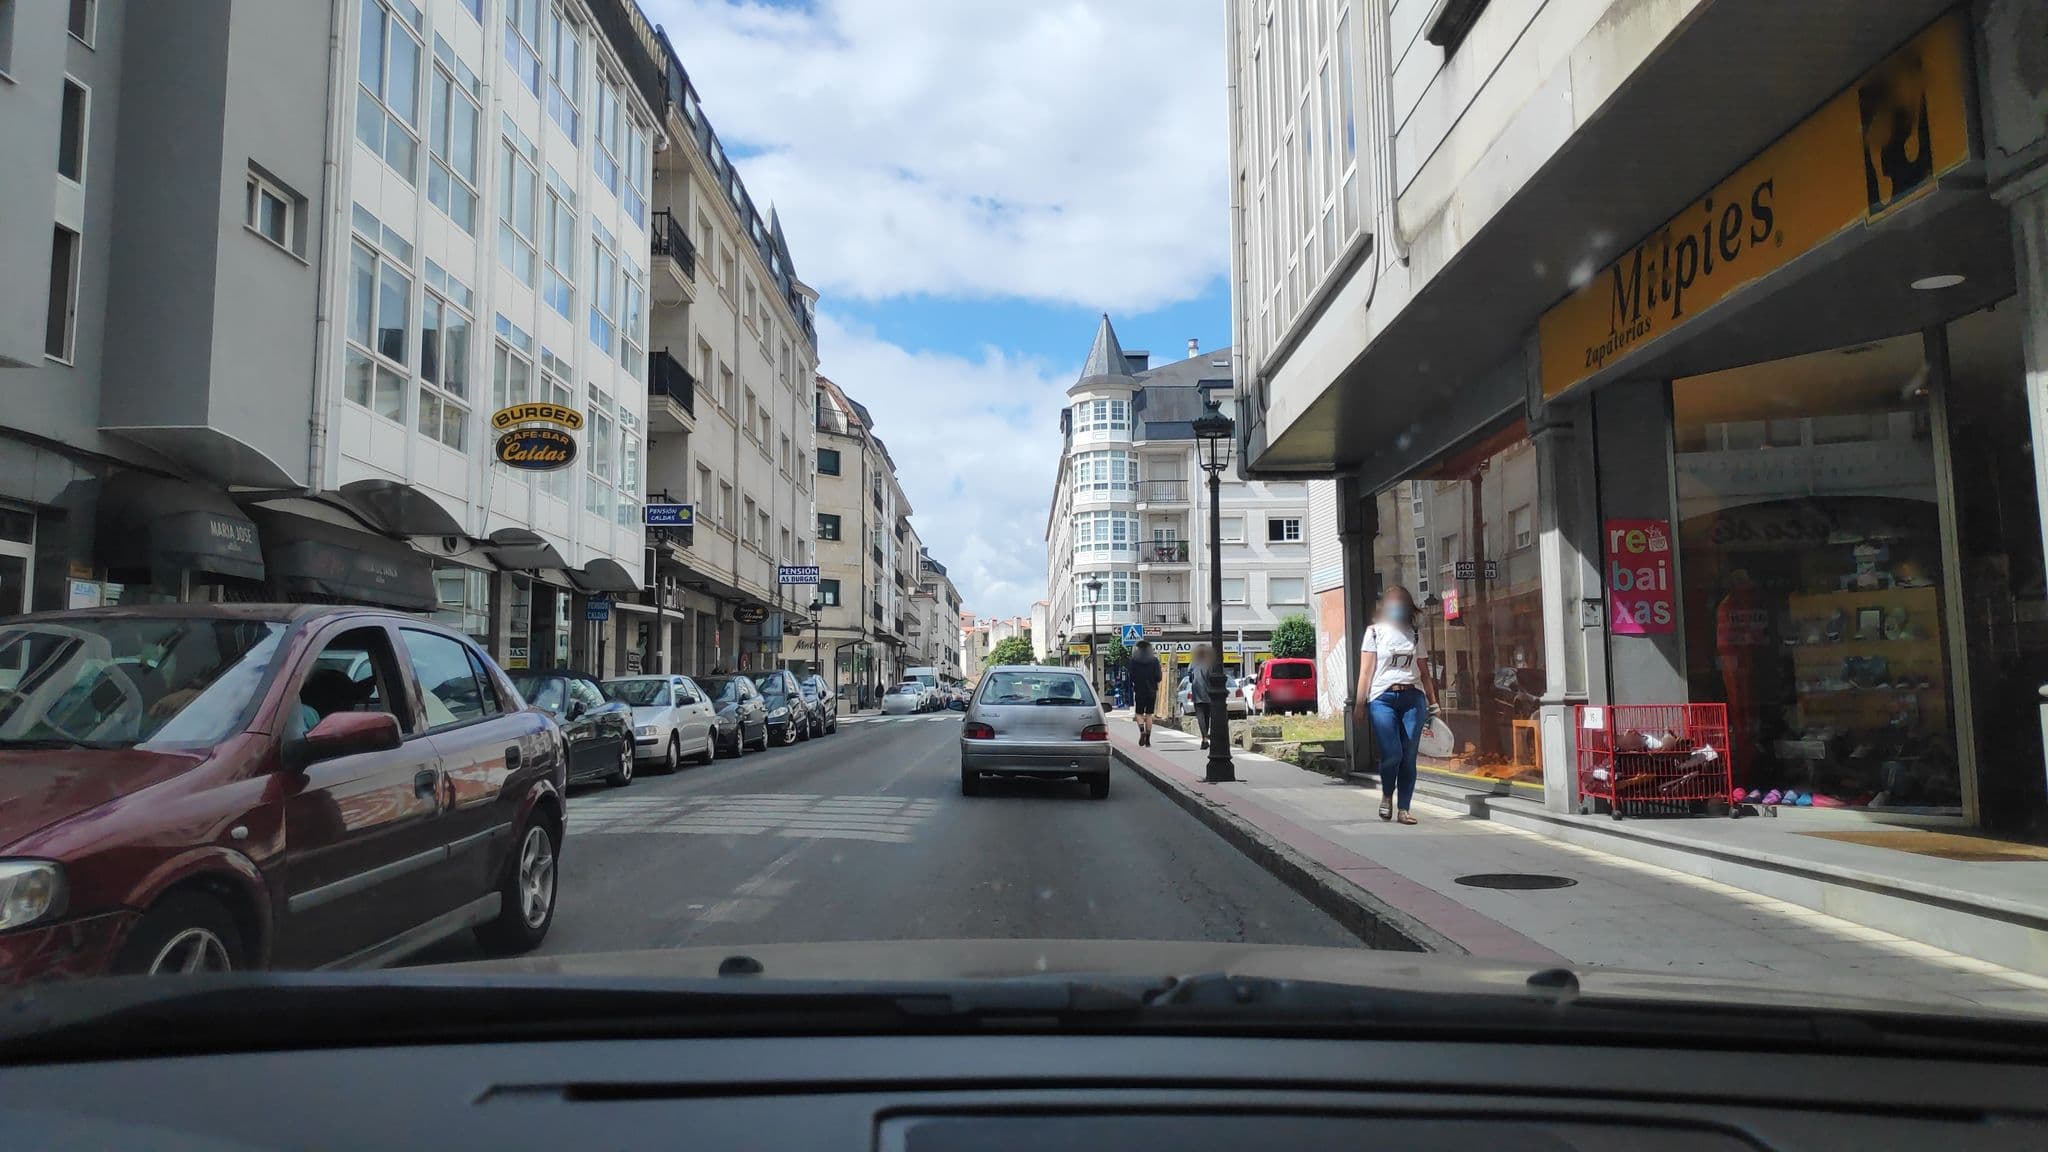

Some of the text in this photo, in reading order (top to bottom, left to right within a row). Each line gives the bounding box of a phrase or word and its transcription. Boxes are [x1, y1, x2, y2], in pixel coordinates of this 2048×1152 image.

[495, 407, 580, 427] BURGER
[502, 442, 567, 461] Caldas
[1611, 529, 1647, 553] re
[1612, 560, 1667, 591] bai
[1616, 601, 1671, 624] xas
